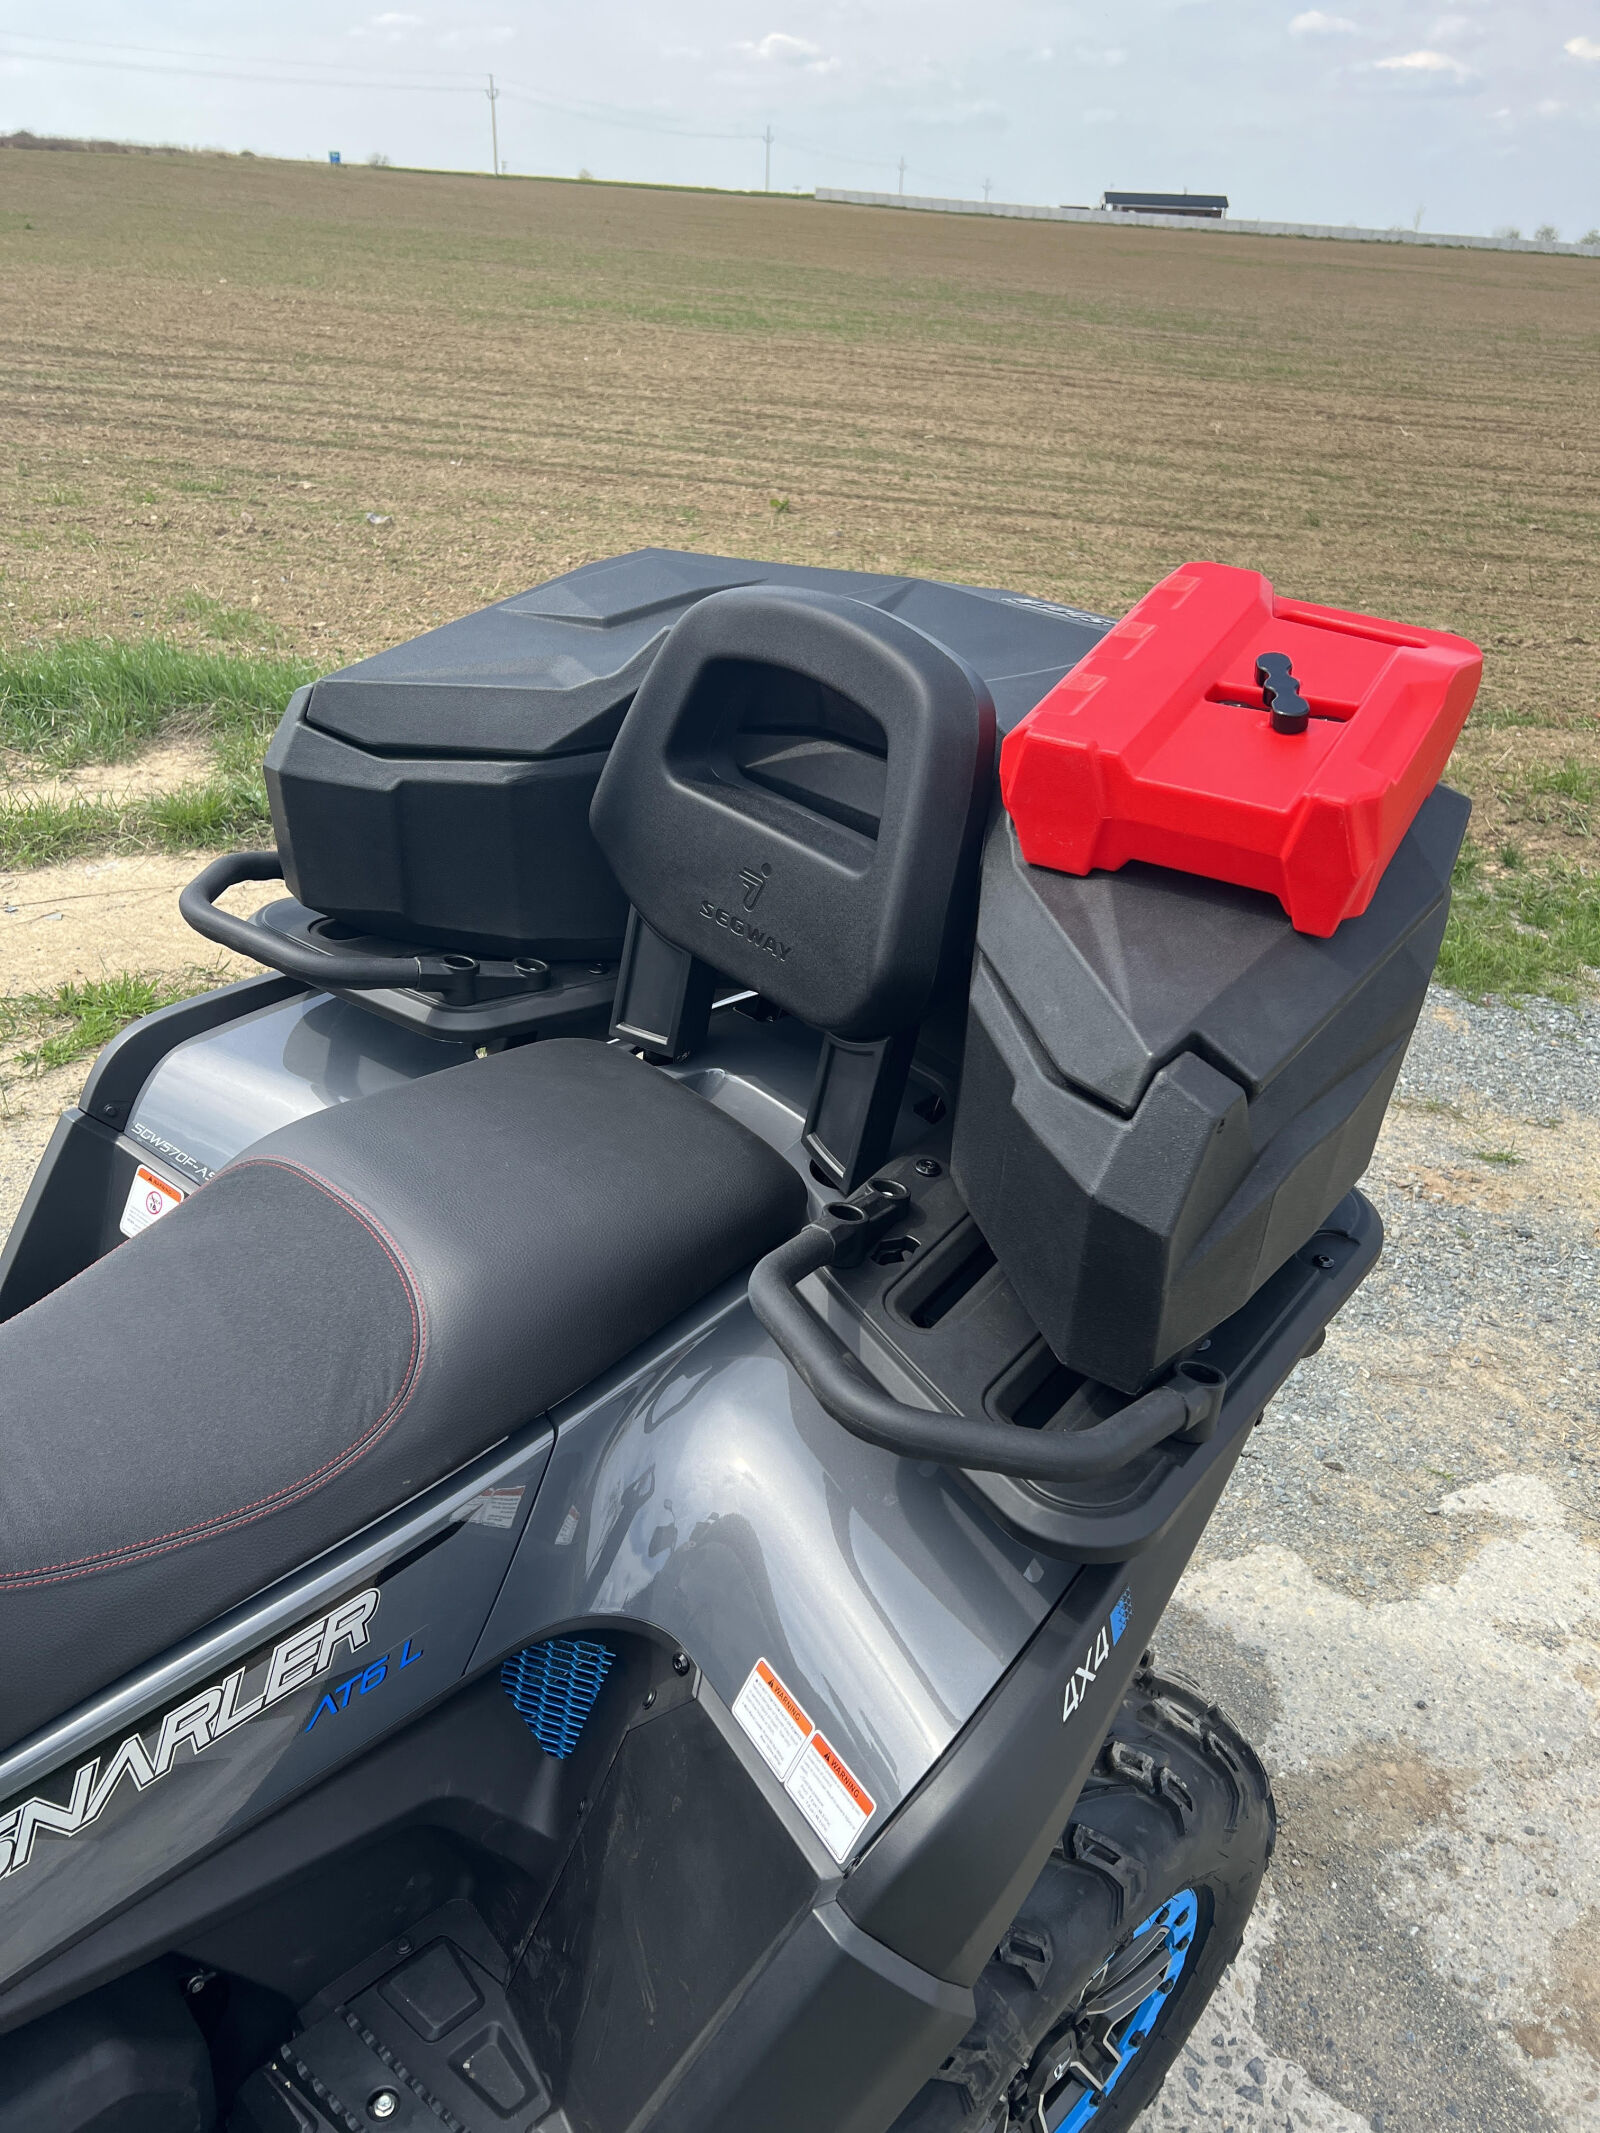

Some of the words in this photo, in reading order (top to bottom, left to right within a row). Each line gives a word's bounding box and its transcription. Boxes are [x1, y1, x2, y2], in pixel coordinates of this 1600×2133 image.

[699, 899, 792, 962] SEGWAY
[304, 1654, 390, 1733] AT6
[399, 1639, 424, 1670] L
[774, 1685, 801, 1722] WARNING
[831, 1760, 860, 1799] WARNING
